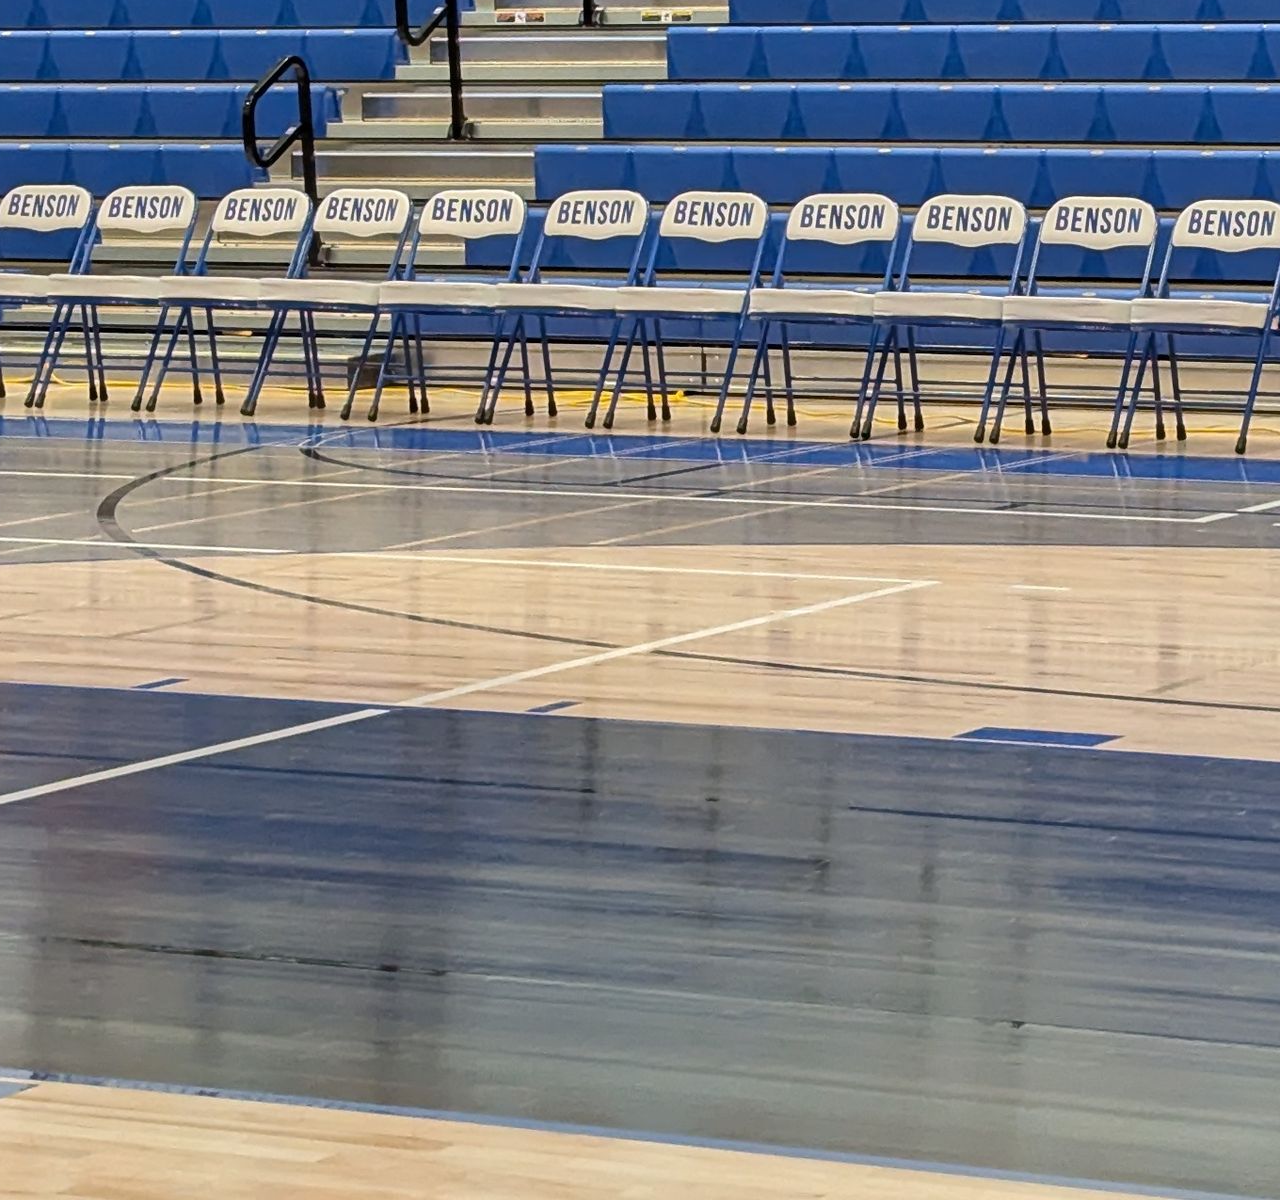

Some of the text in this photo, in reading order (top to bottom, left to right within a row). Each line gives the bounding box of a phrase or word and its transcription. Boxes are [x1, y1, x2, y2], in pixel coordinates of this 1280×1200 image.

[7, 194, 80, 218] BENSON
[108, 196, 184, 220] BENSON
[224, 197, 297, 222] BENSON
[325, 196, 399, 223] BENSON
[431, 197, 513, 223] BENSON
[556, 200, 635, 225] BENSON
[673, 200, 755, 227] BENSON
[800, 204, 885, 230] BENSON
[926, 205, 1013, 233] BENSON
[1054, 206, 1143, 234] BENSON
[1187, 208, 1276, 237] BENSON
